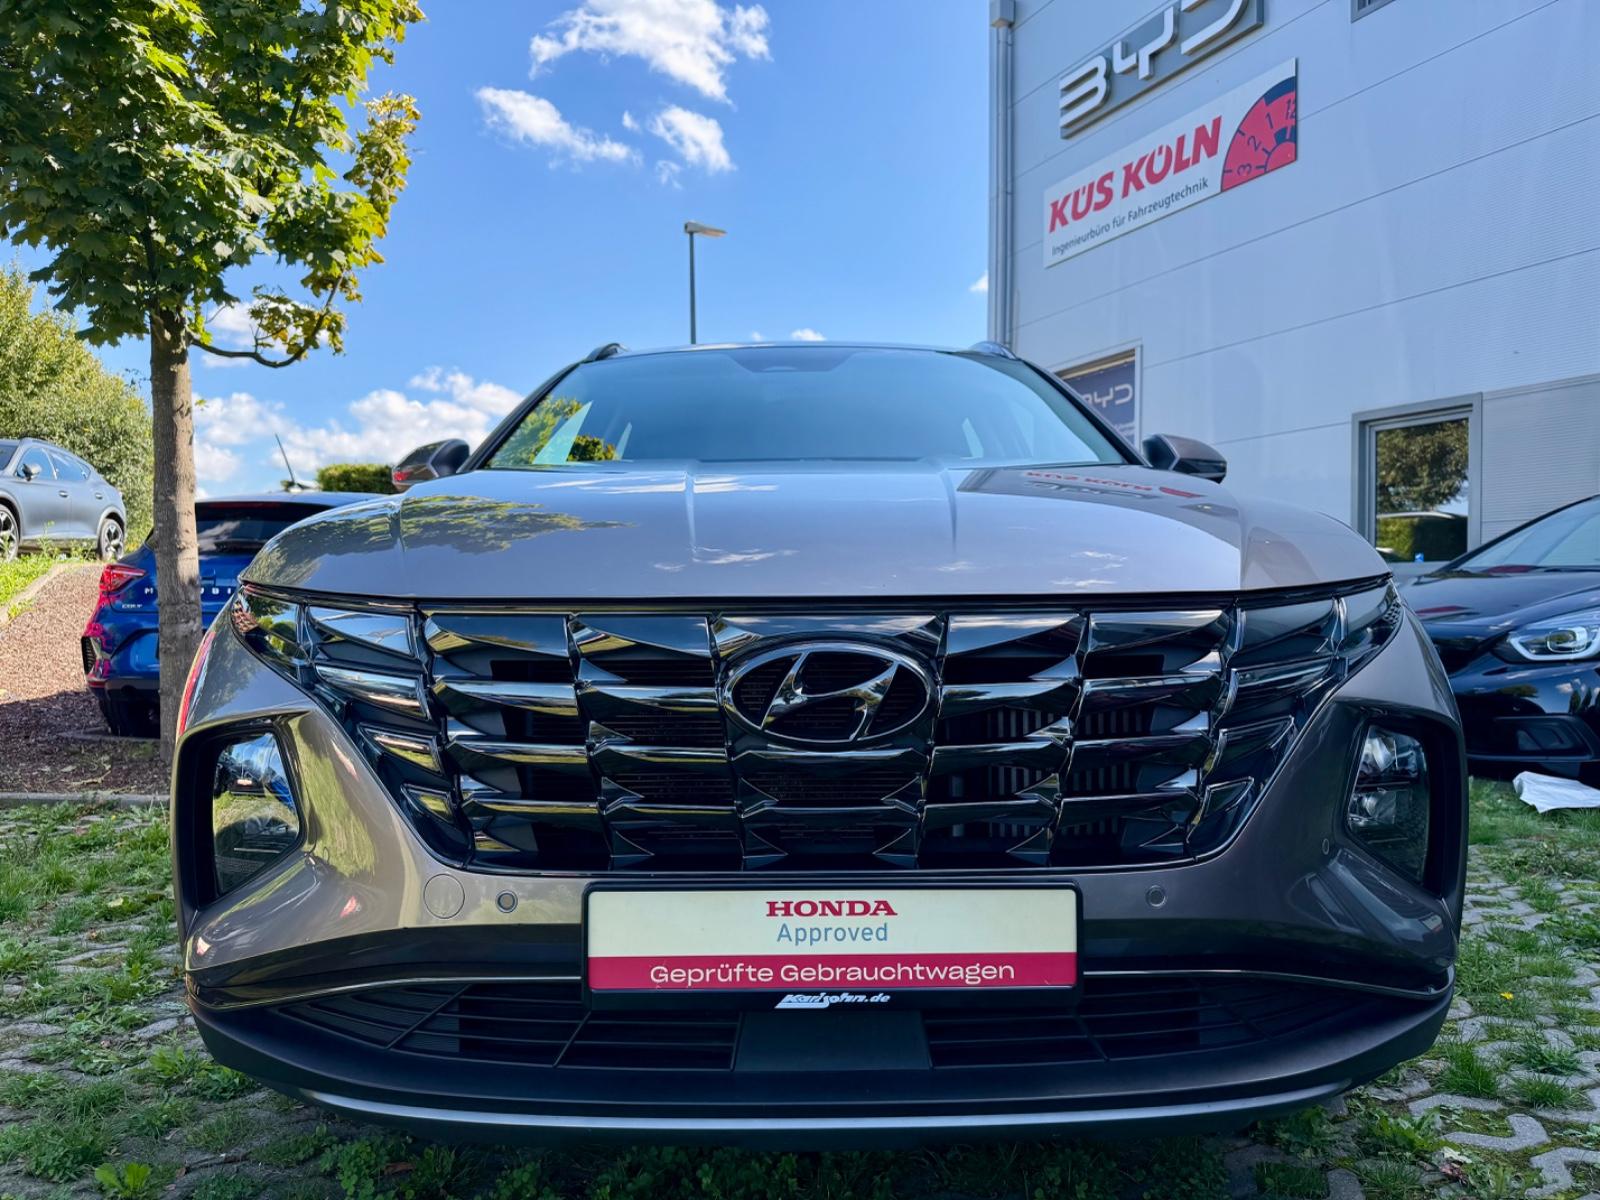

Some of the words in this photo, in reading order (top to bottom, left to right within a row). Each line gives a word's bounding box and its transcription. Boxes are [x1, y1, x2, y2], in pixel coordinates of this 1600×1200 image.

[1049, 171, 1114, 233] KÜS
[1121, 115, 1222, 199] KÖLN
[1052, 223, 1110, 256] Ingenieurbüro
[1112, 214, 1125, 229] für
[1128, 177, 1209, 223] Fahrzeugtechnik
[766, 900, 898, 917] HONDA
[777, 922, 888, 946] Approved
[650, 964, 774, 986] Geprüfte
[780, 962, 1015, 985] Gebrauchtwagen
